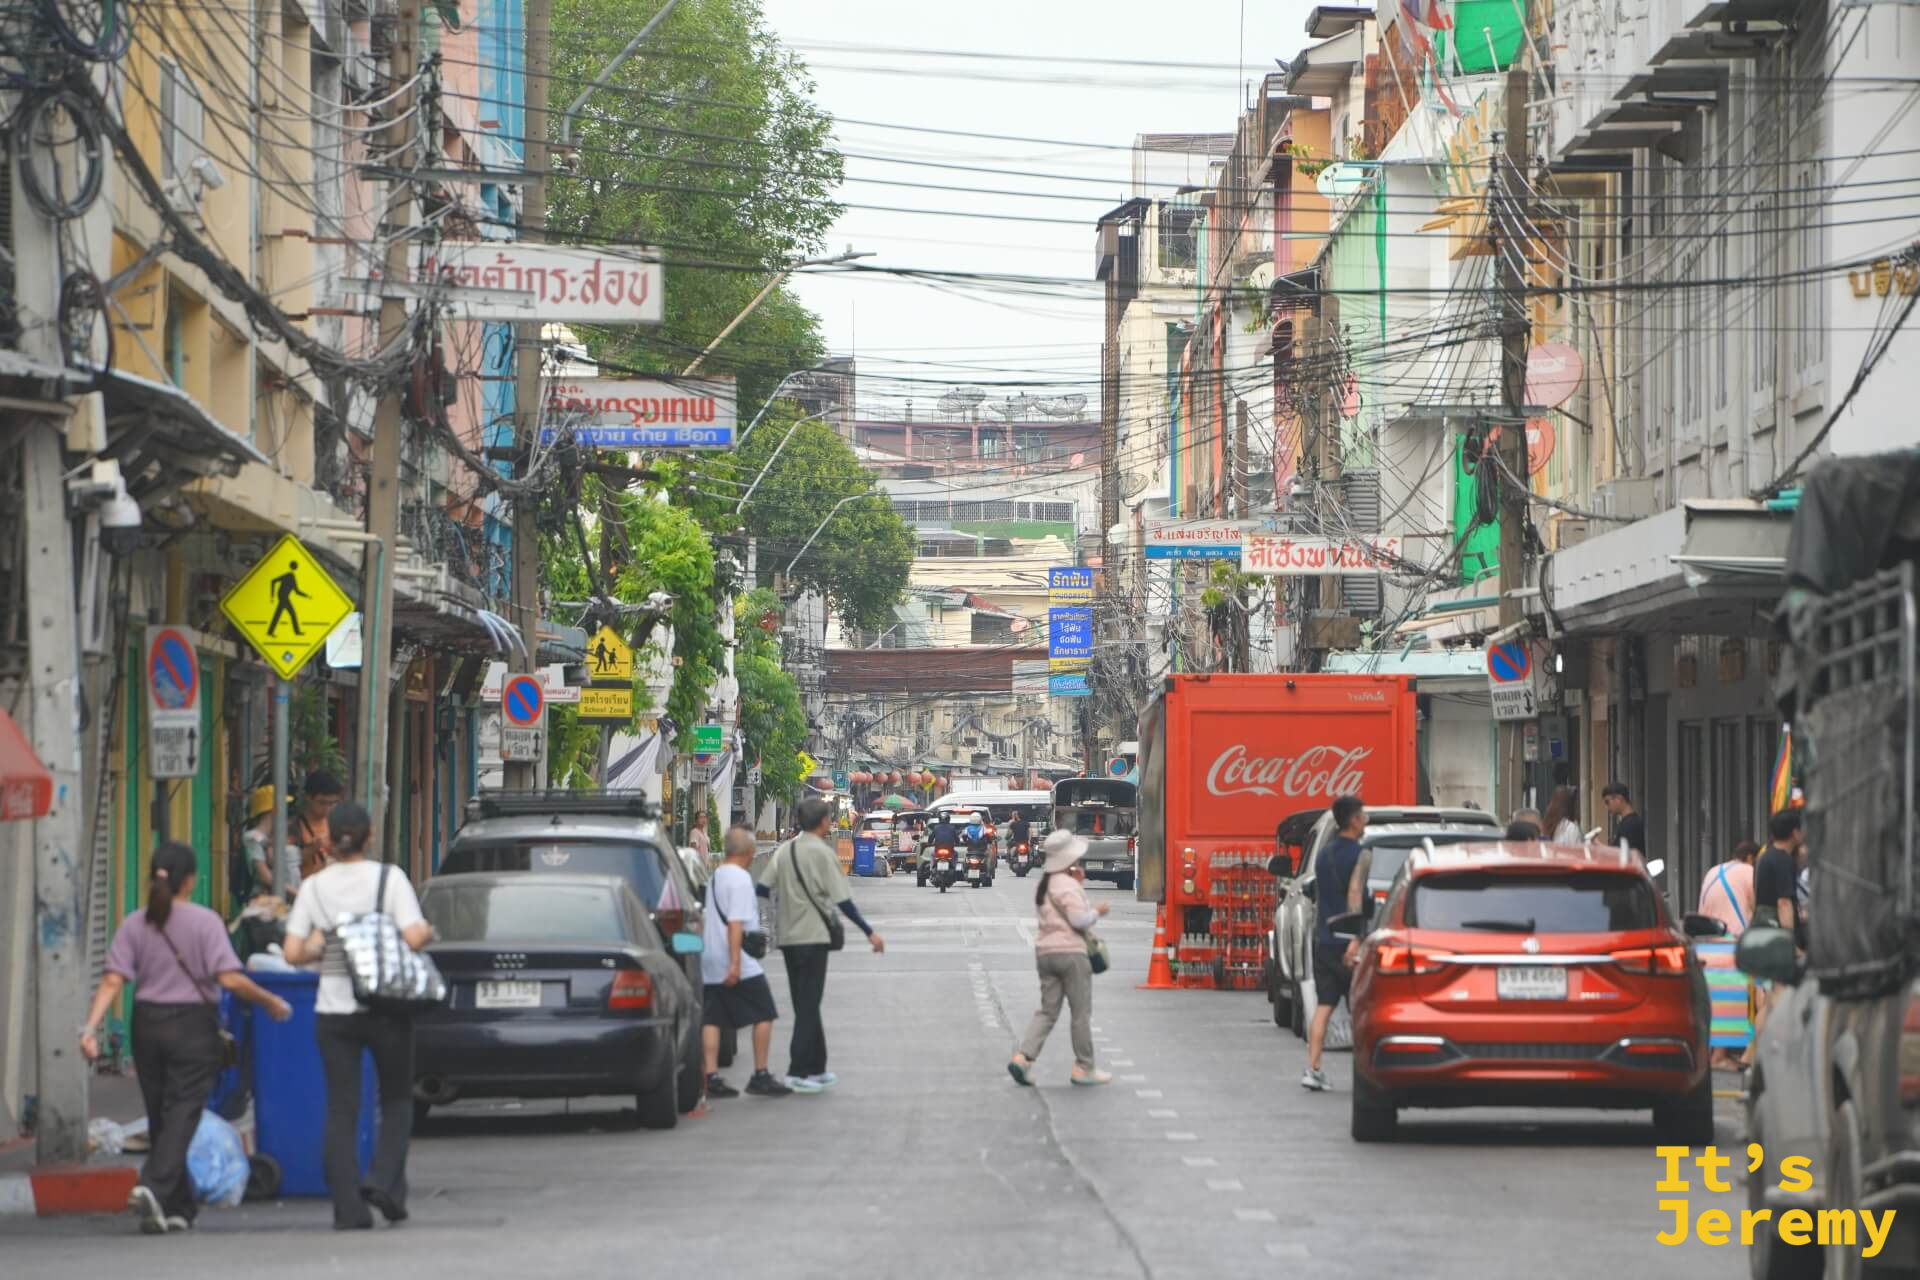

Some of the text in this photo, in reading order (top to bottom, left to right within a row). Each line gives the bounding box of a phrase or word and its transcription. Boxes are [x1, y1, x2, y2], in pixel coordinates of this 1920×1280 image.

[1052, 571, 1089, 587] รักฟัน
[1207, 744, 1374, 797] Coca-Cola
